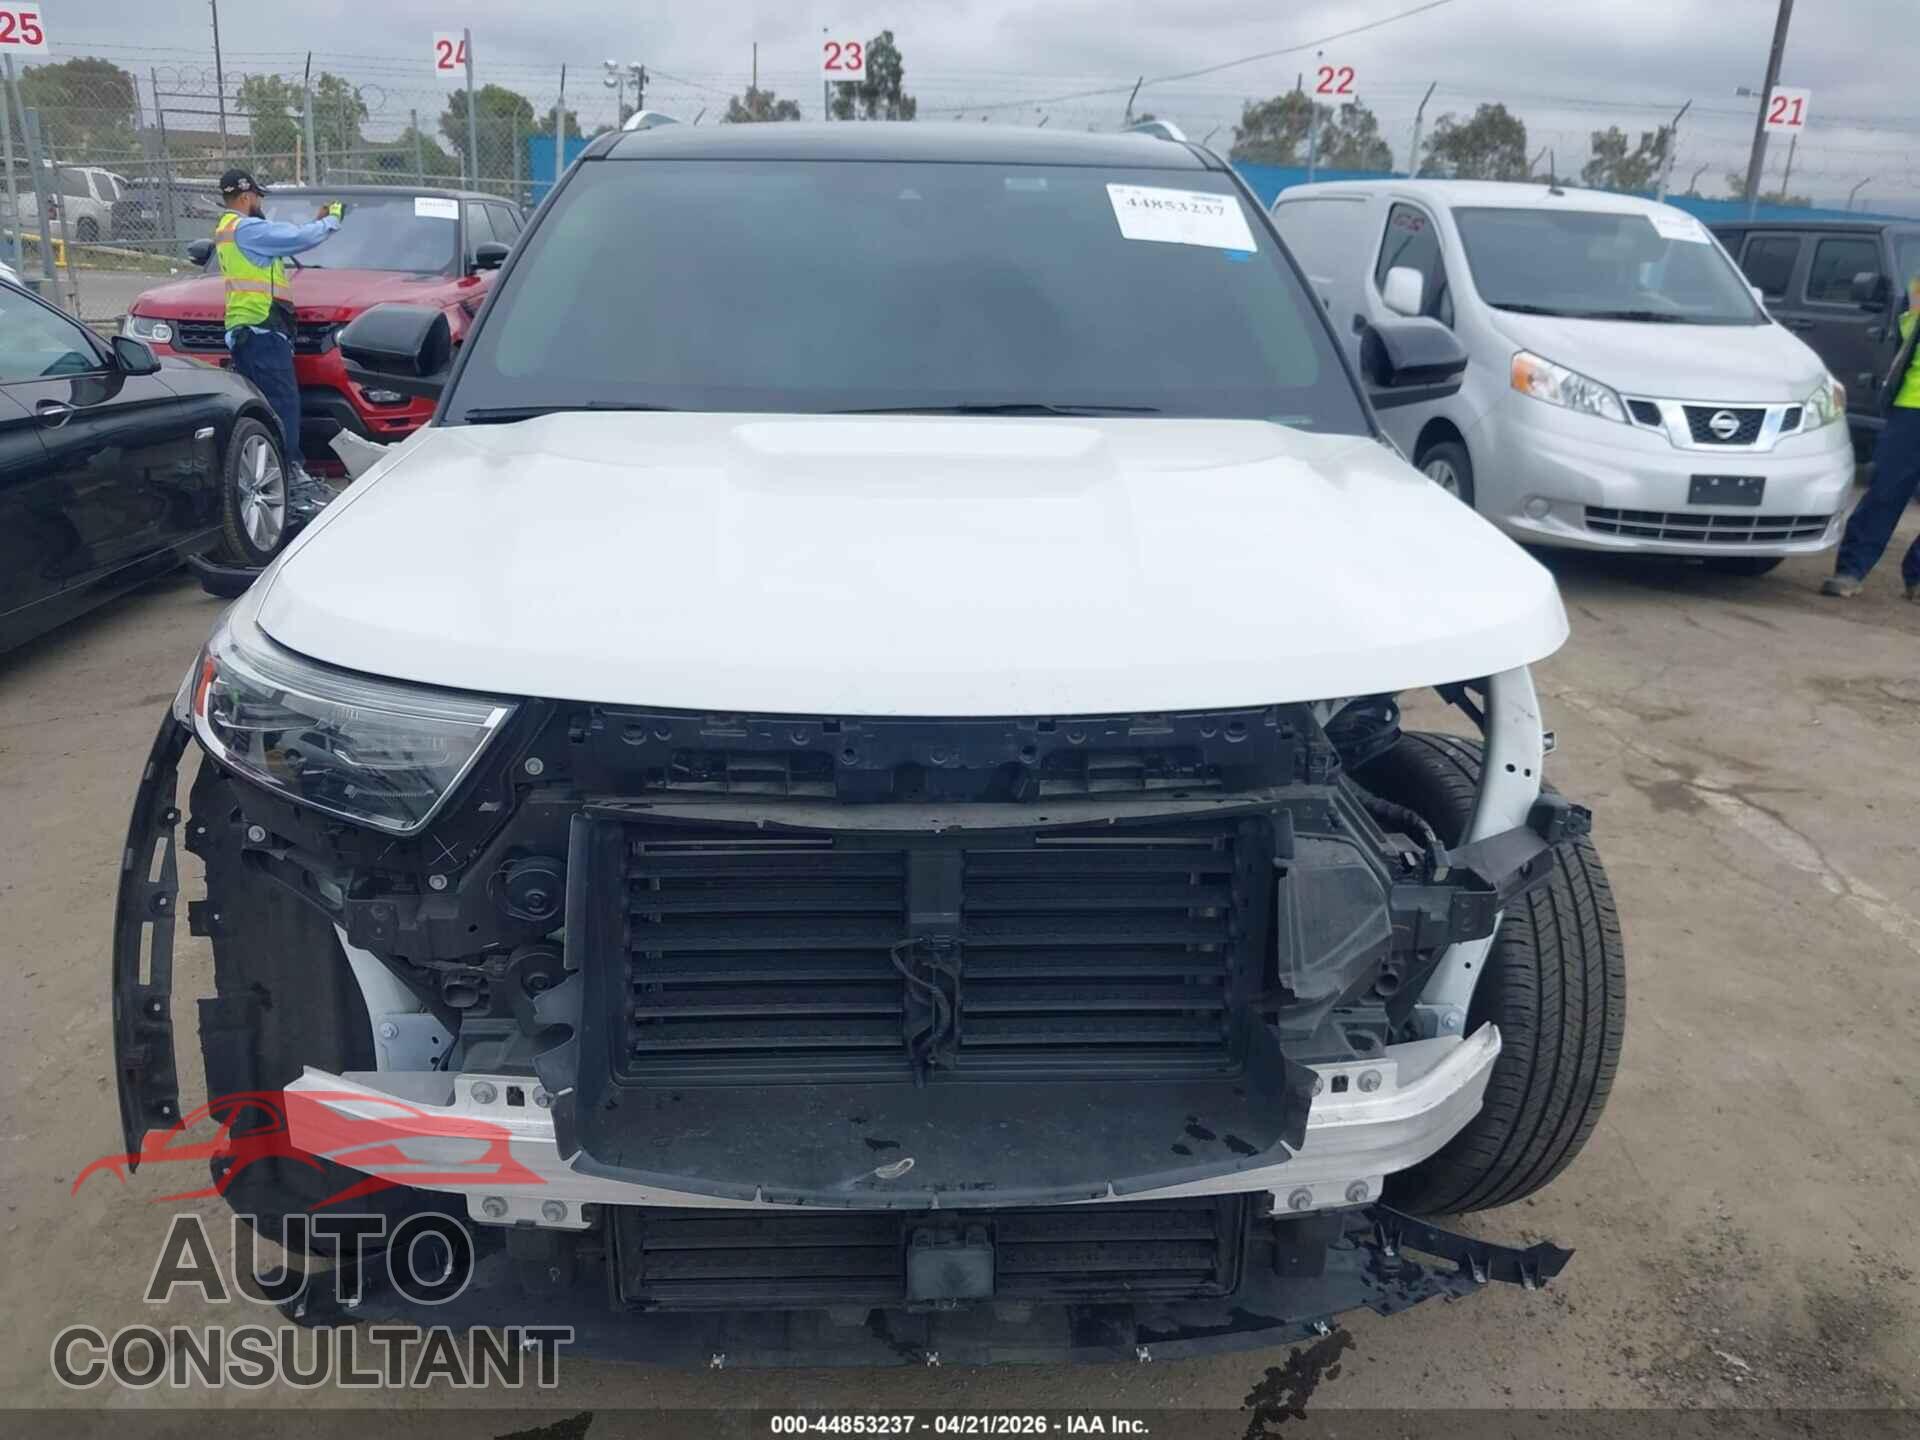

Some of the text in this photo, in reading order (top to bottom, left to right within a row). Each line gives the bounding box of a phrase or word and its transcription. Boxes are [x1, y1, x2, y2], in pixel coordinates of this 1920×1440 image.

[0, 11, 43, 45] 25
[824, 41, 862, 70] 23
[1316, 66, 1354, 94] 22
[1767, 96, 1803, 126] 21
